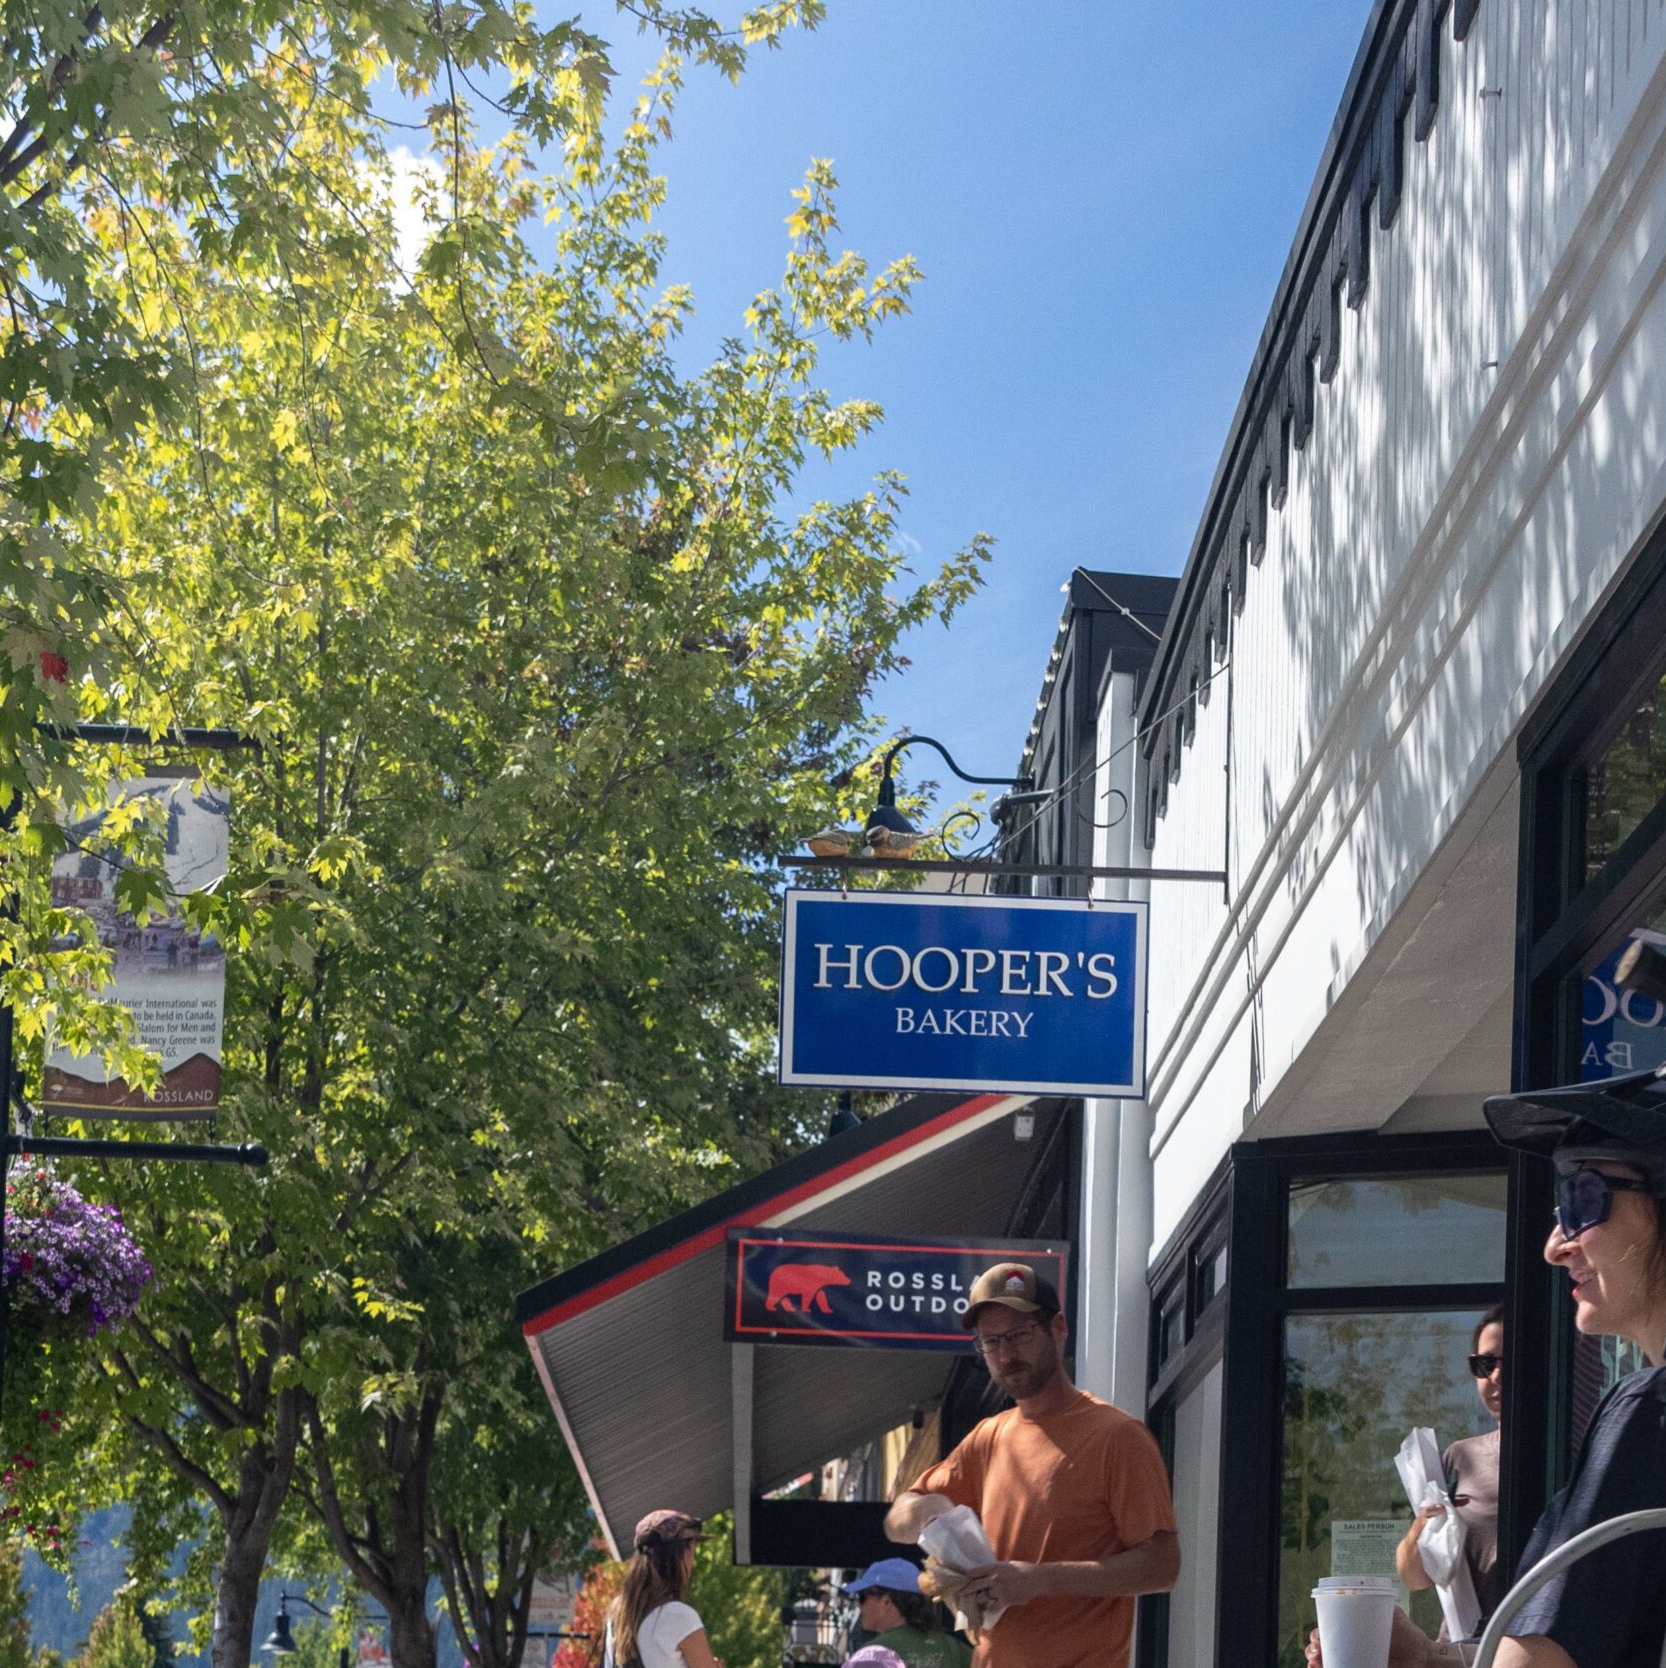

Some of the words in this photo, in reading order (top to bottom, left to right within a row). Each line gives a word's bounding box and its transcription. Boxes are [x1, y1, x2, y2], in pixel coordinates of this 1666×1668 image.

[813, 943, 1118, 999] HOOPER'S
[146, 998, 198, 1008] International
[202, 1000, 217, 1008] was
[144, 1010, 154, 1020] be
[156, 1010, 173, 1020] held
[175, 1010, 183, 1020] in
[185, 1009, 216, 1020] Canada.
[167, 1023, 178, 1032] for
[181, 1022, 198, 1032] Men
[201, 1022, 216, 1032] and
[895, 1007, 1034, 1038] BAKERY
[141, 1035, 166, 1046] Nancy
[169, 1035, 197, 1045] Greene
[200, 1036, 215, 1044] was
[867, 1271, 981, 1291] ROSSL
[865, 1294, 970, 1314] OUTDO
